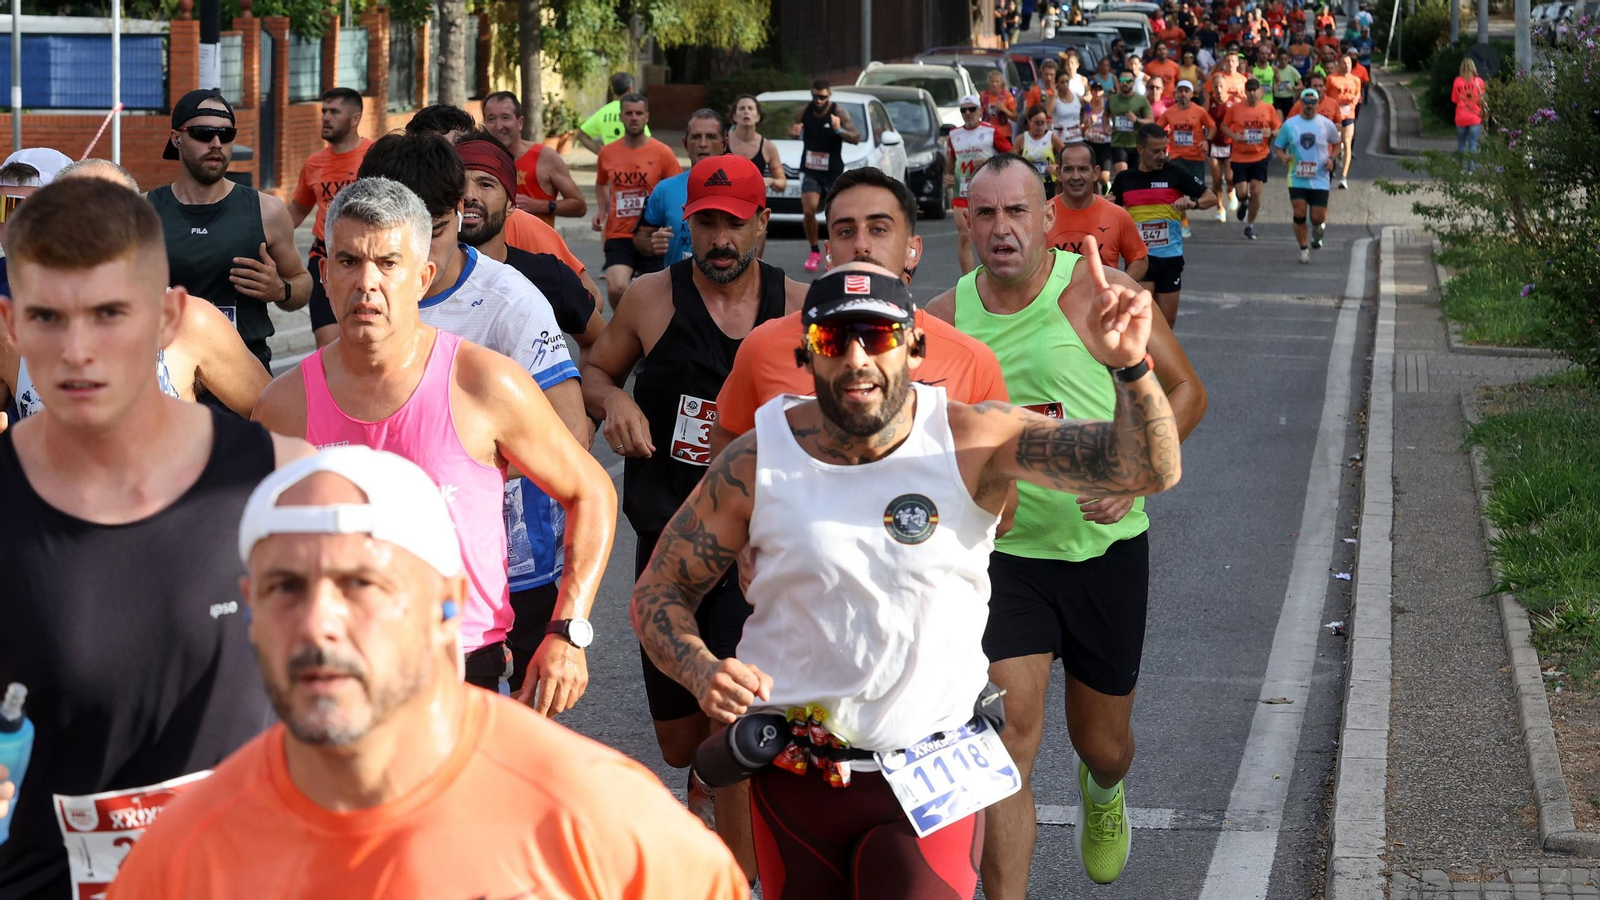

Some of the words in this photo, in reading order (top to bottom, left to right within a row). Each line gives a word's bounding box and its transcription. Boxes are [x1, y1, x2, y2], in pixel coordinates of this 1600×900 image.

[191, 227, 208, 235] FILA
[1143, 231, 1161, 240] 547
[913, 743, 990, 793] 1118
